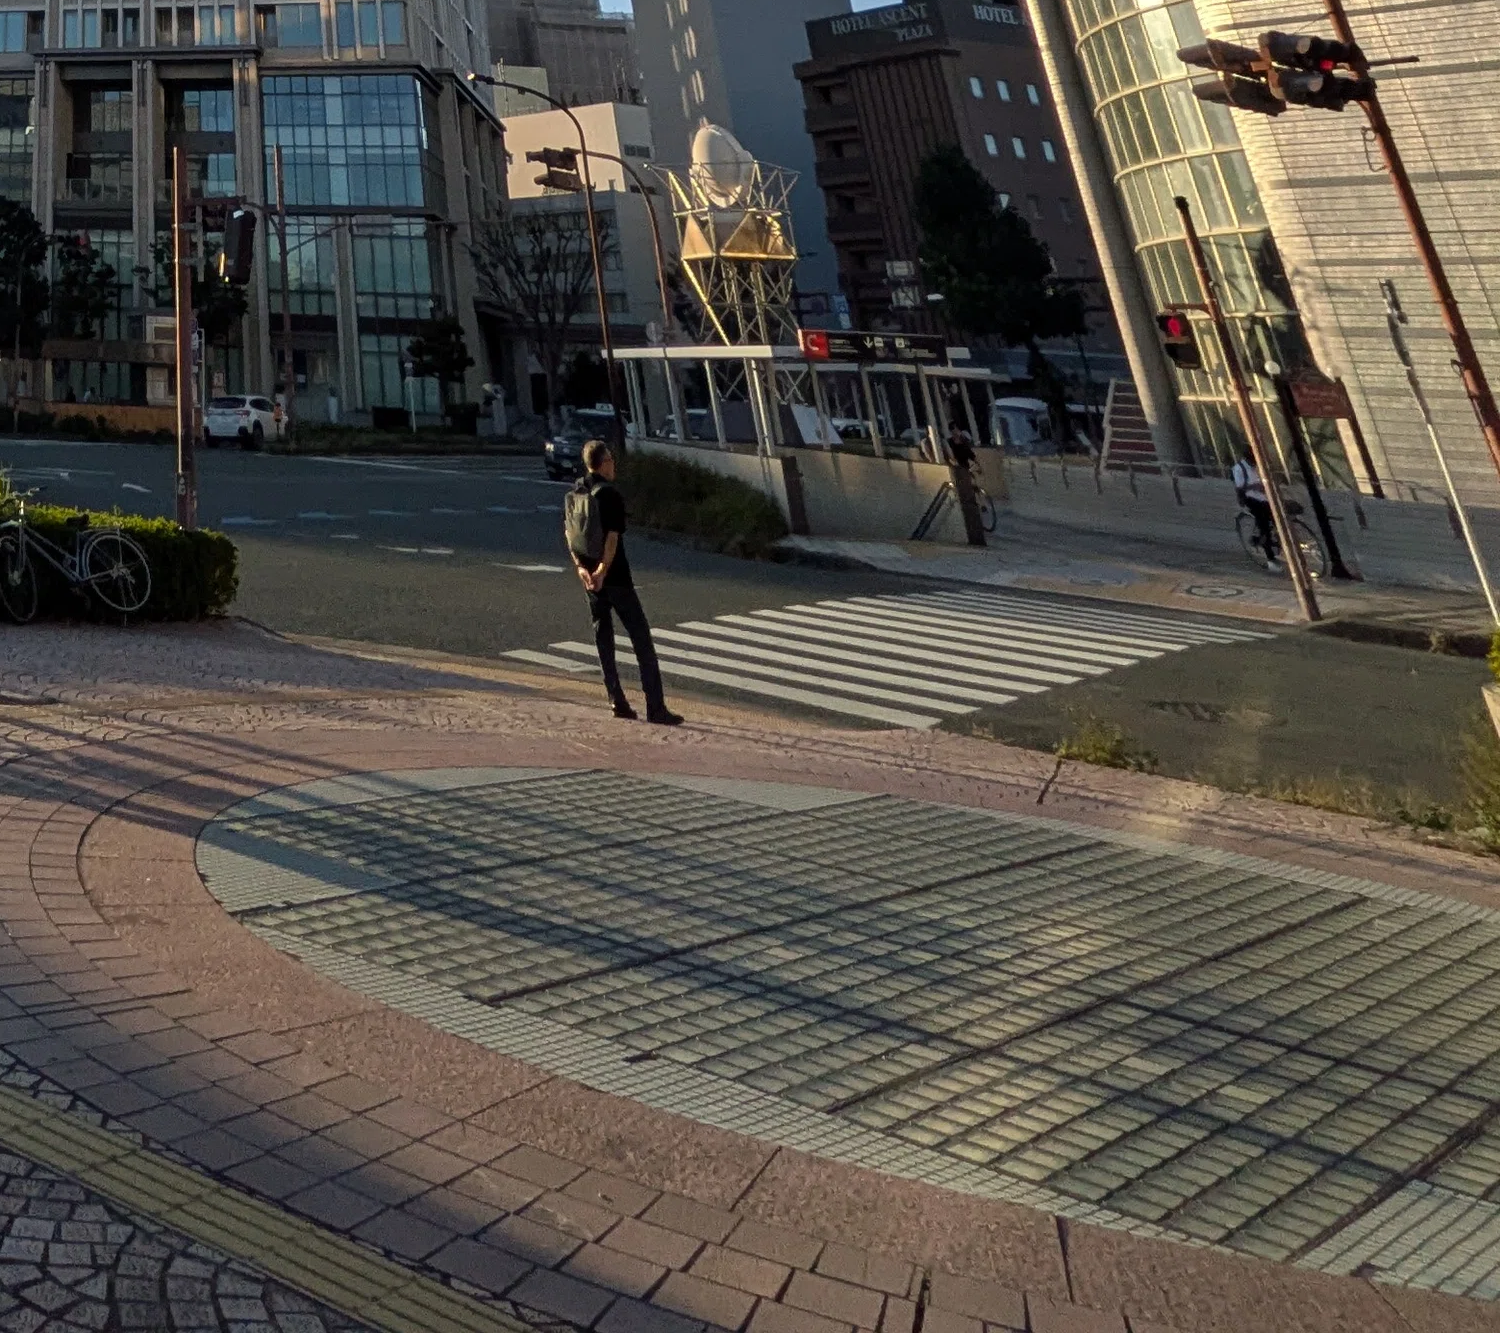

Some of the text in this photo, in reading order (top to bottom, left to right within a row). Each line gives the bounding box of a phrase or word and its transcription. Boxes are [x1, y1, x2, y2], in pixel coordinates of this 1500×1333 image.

[831, 2, 928, 36] HOTEL ASCENT
[971, 4, 1019, 26] HOTEL
